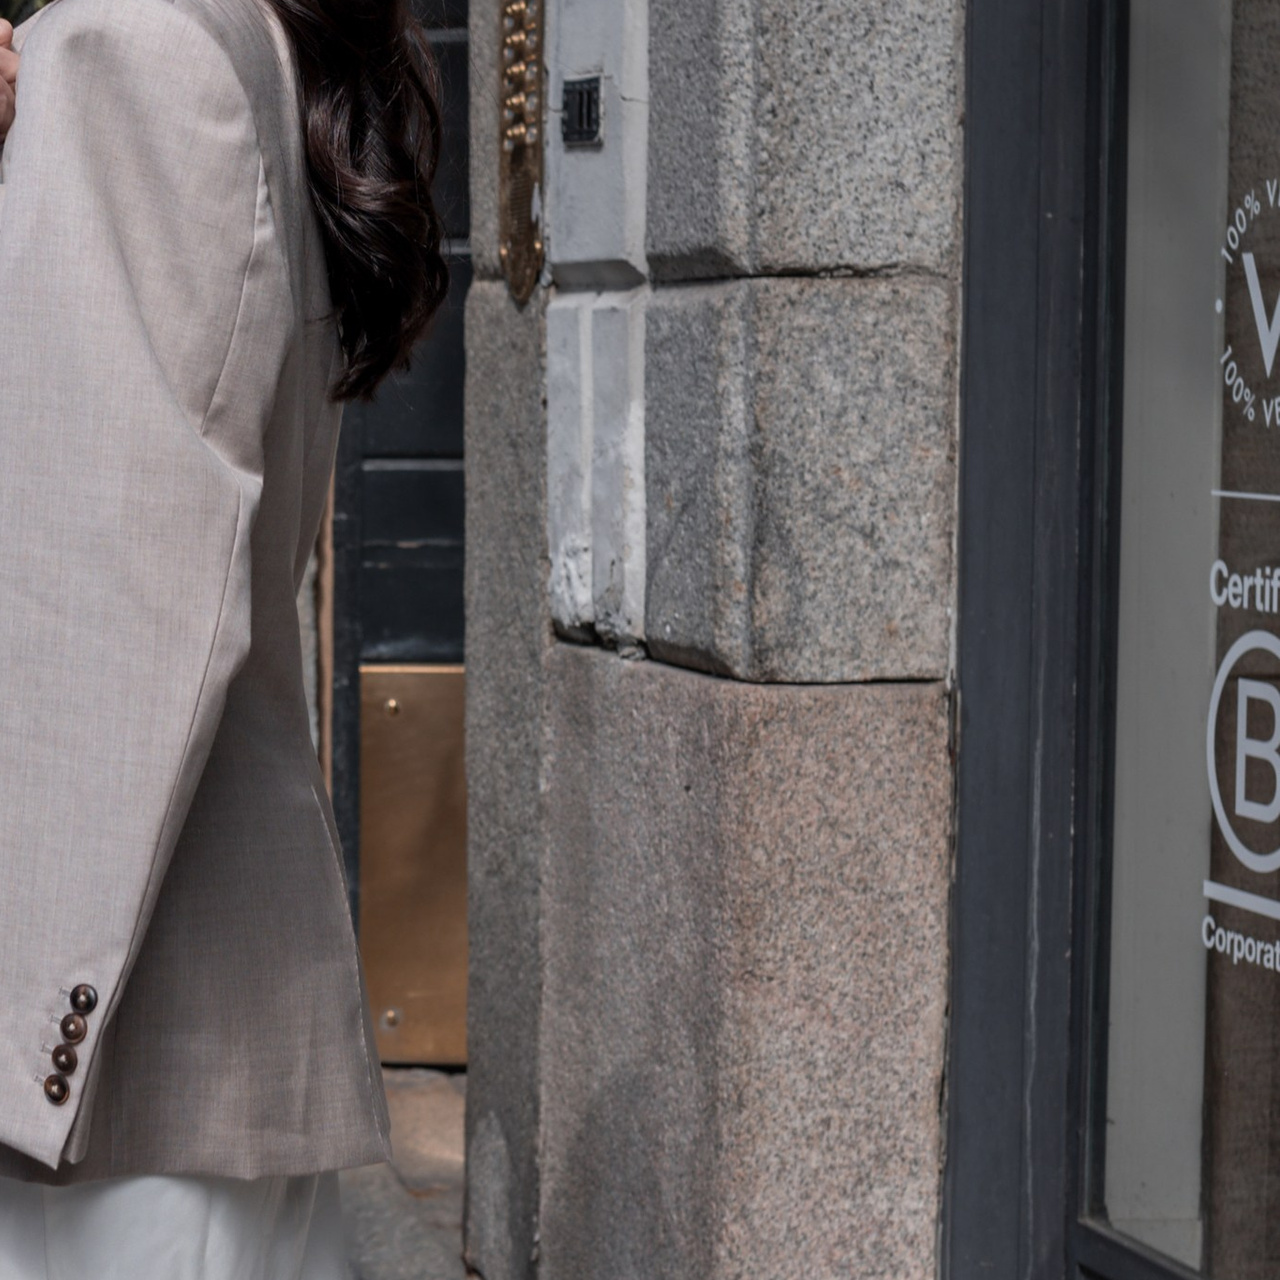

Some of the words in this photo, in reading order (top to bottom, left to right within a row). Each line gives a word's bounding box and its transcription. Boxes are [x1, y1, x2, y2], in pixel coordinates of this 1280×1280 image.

[1221, 188, 1261, 264] 100%
[1266, 179, 1280, 208] V
[1220, 345, 1255, 421] 100%
